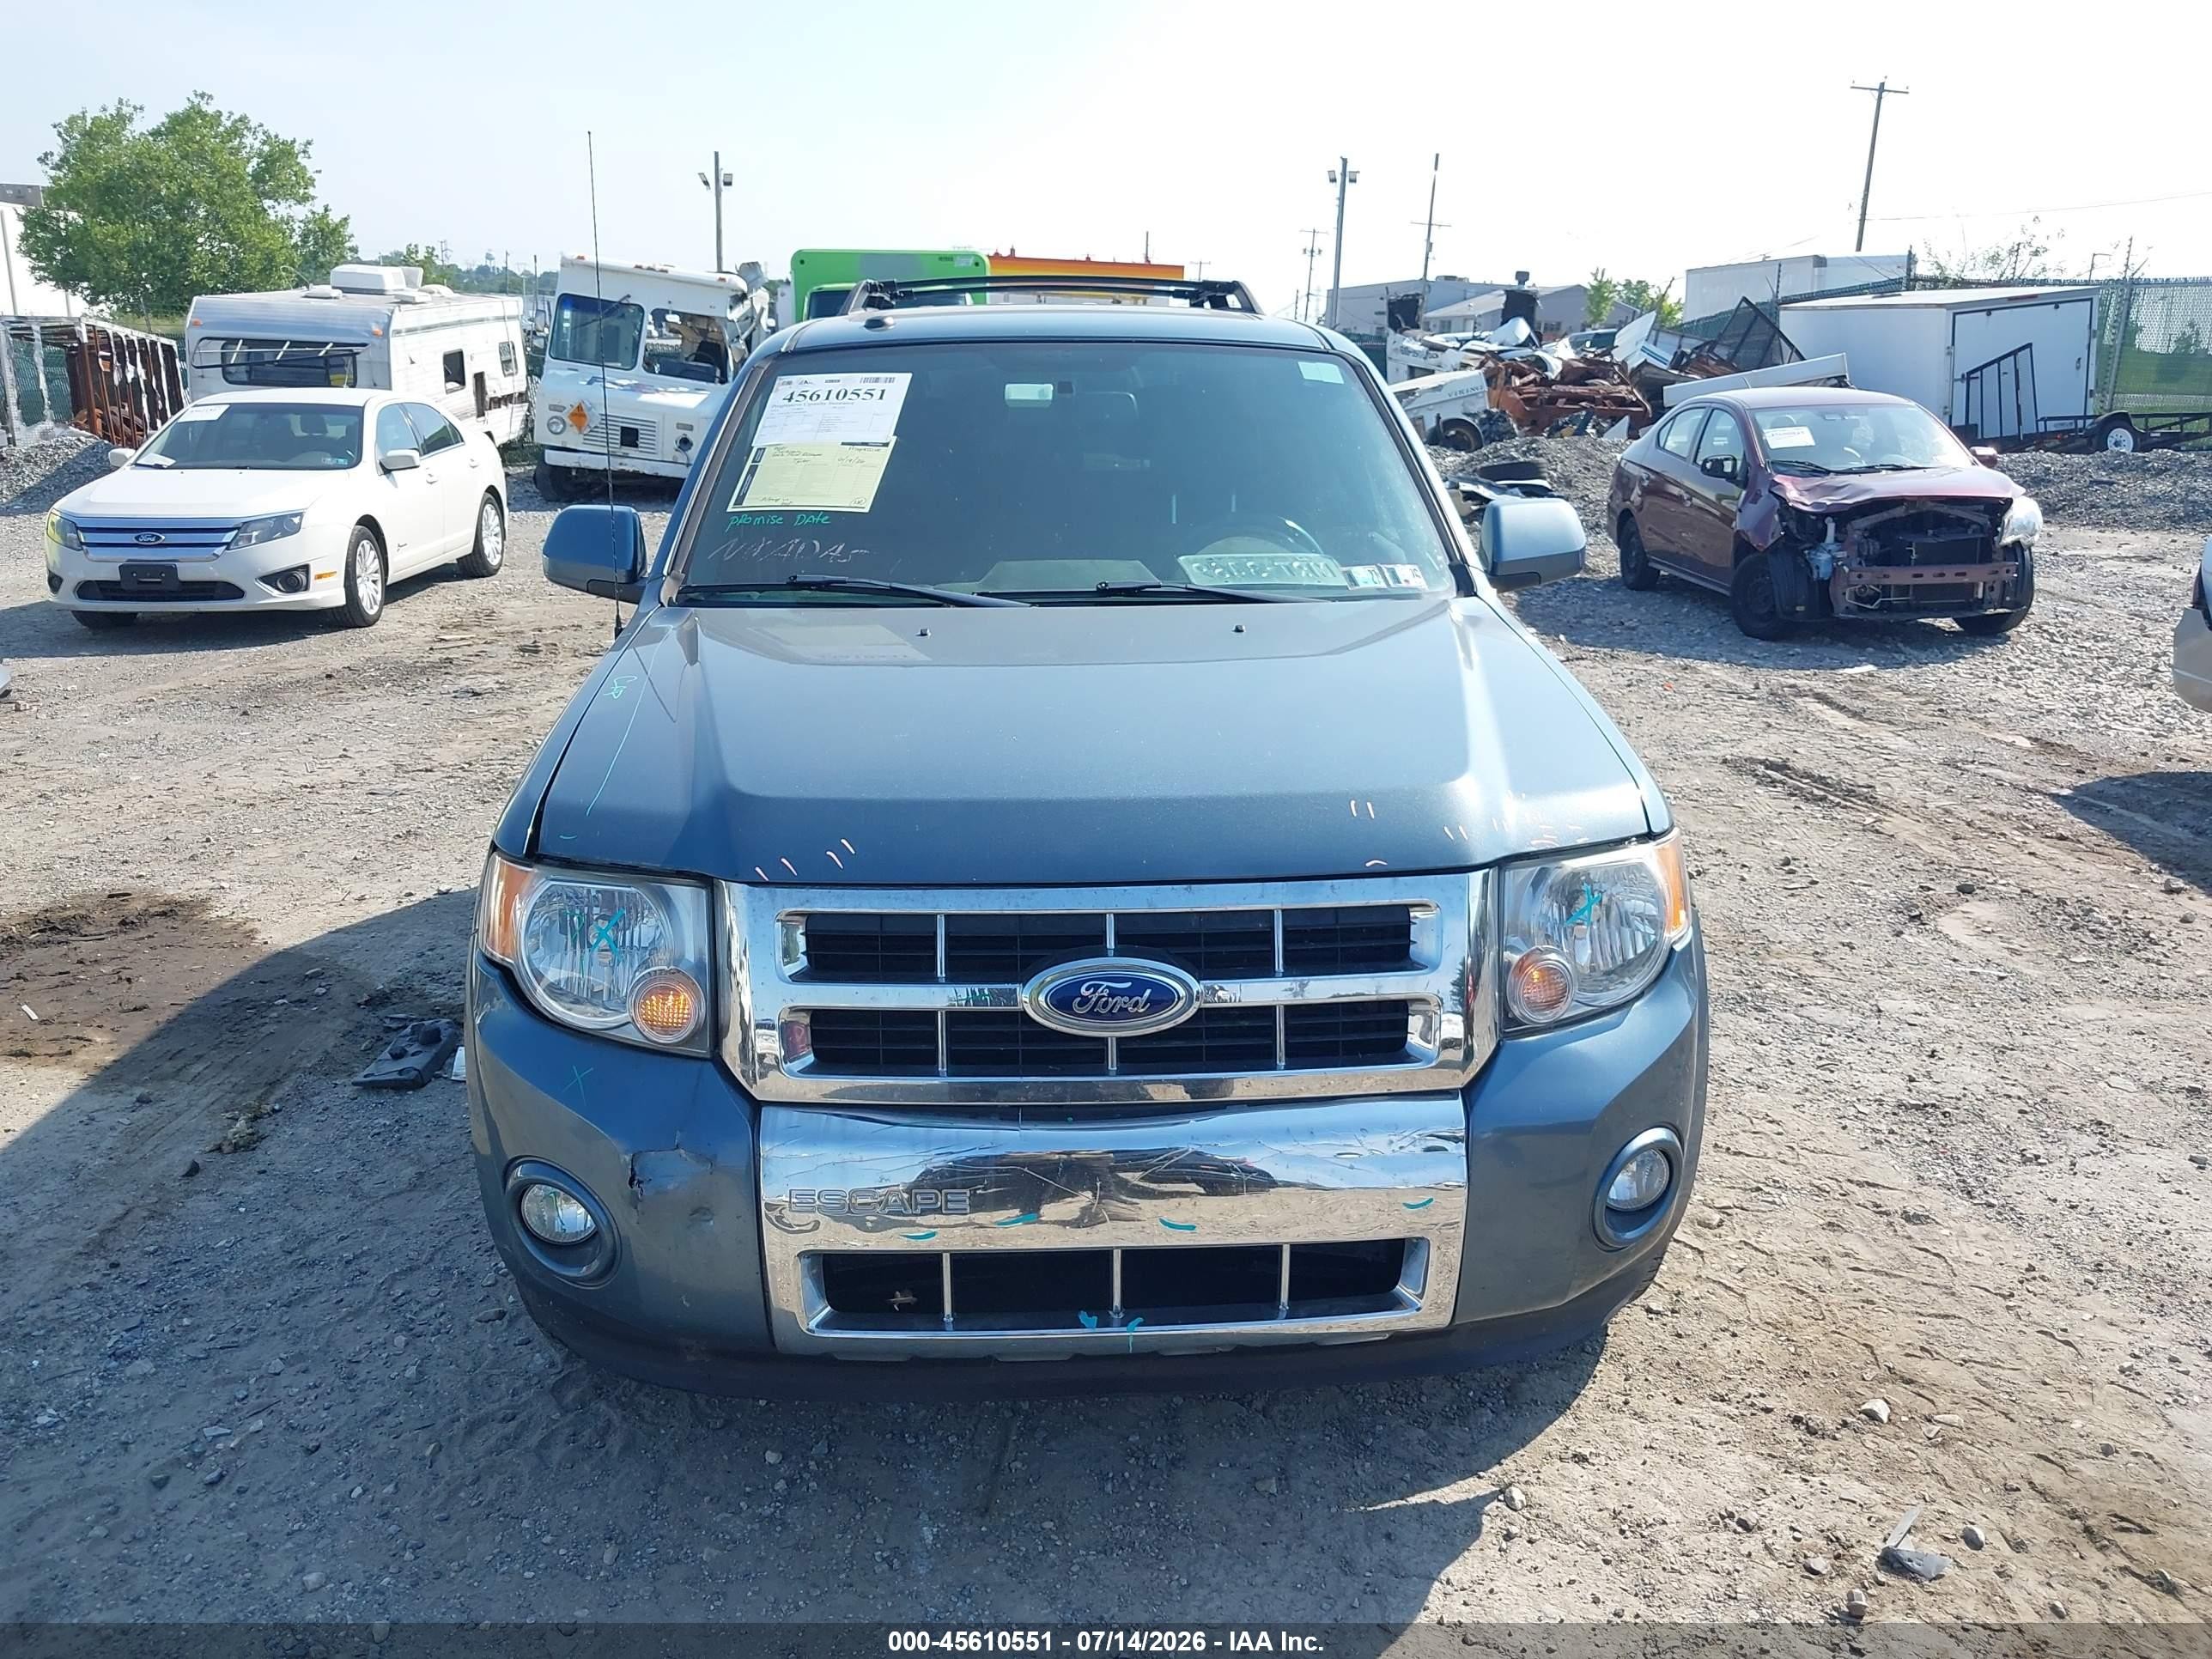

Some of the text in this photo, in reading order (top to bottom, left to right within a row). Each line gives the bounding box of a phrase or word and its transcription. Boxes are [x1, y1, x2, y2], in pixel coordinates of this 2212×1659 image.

[782, 387, 886, 404] 45610551
[1447, 385, 1484, 398] VIKING
[1072, 981, 1152, 1014] Ford
[788, 1188, 970, 1215] ESCAPE
